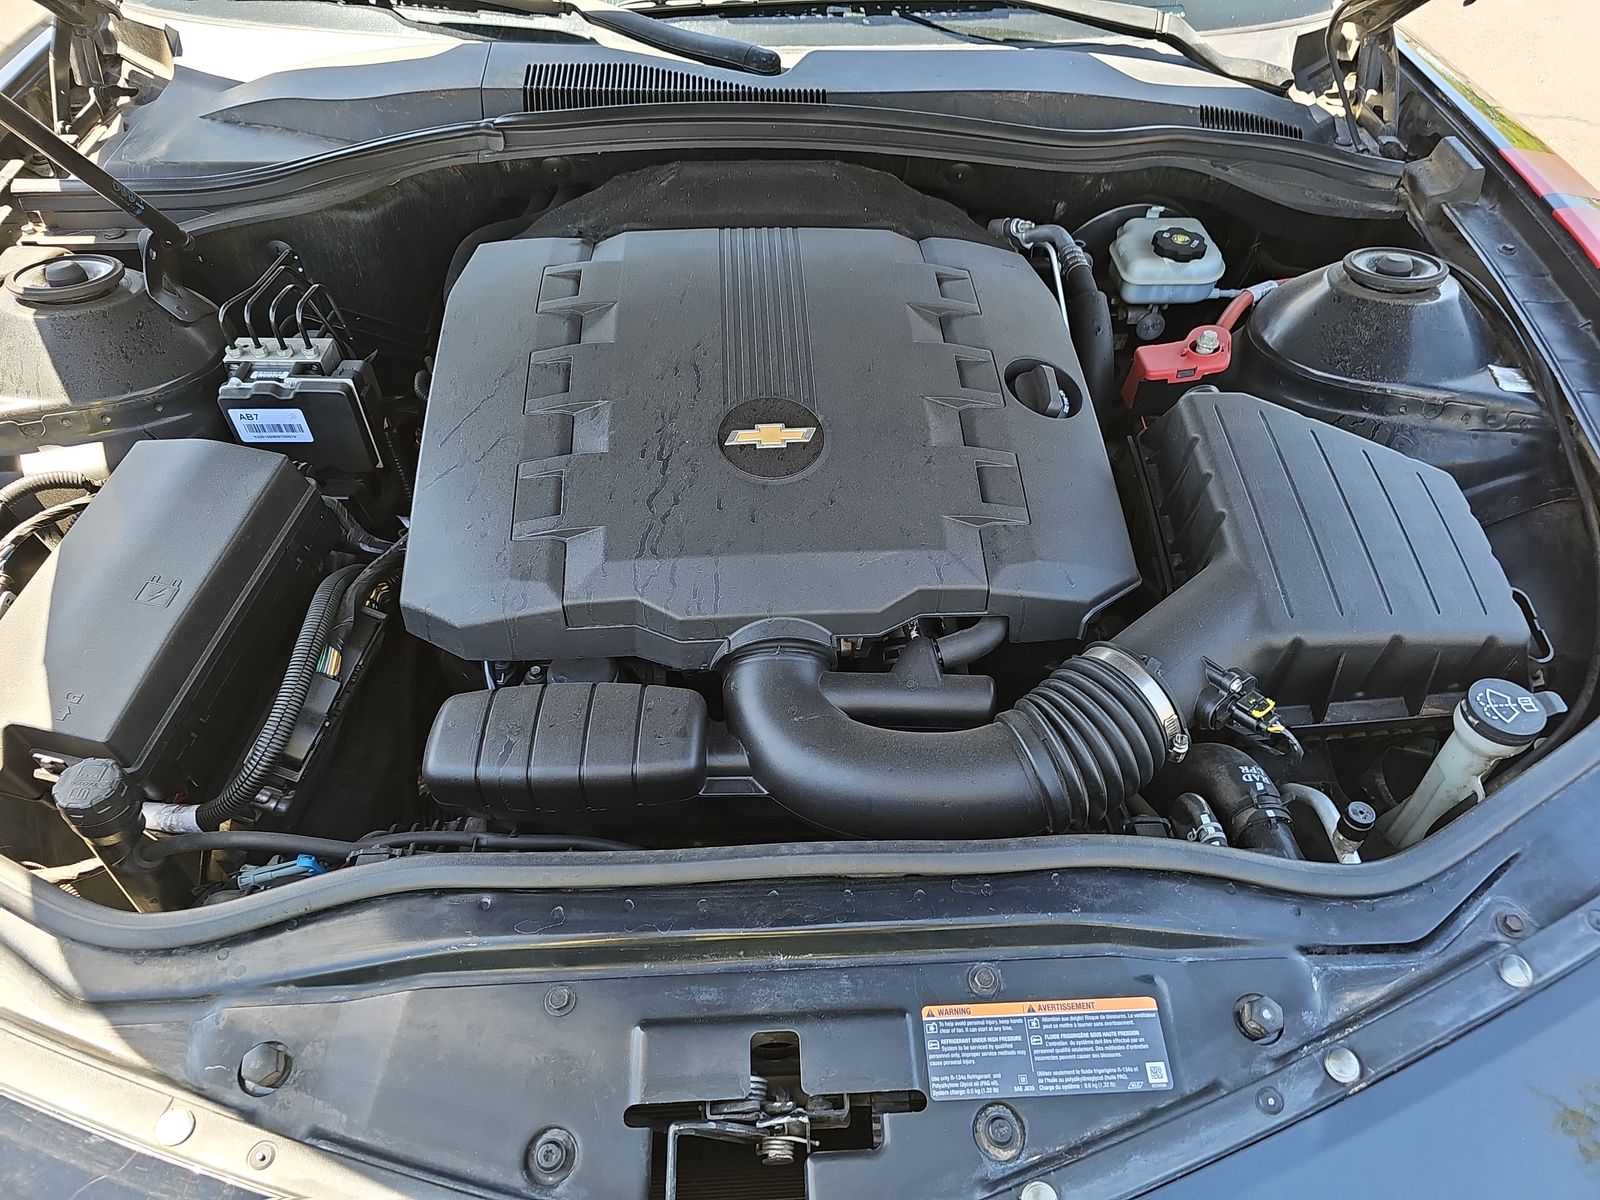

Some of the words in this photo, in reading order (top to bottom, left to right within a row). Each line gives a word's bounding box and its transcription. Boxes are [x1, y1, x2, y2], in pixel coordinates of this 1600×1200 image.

[1242, 774, 1270, 784] RAD
[1038, 1002, 1094, 1011] AVERTISSEMENT
[938, 1007, 971, 1016] WARNING
